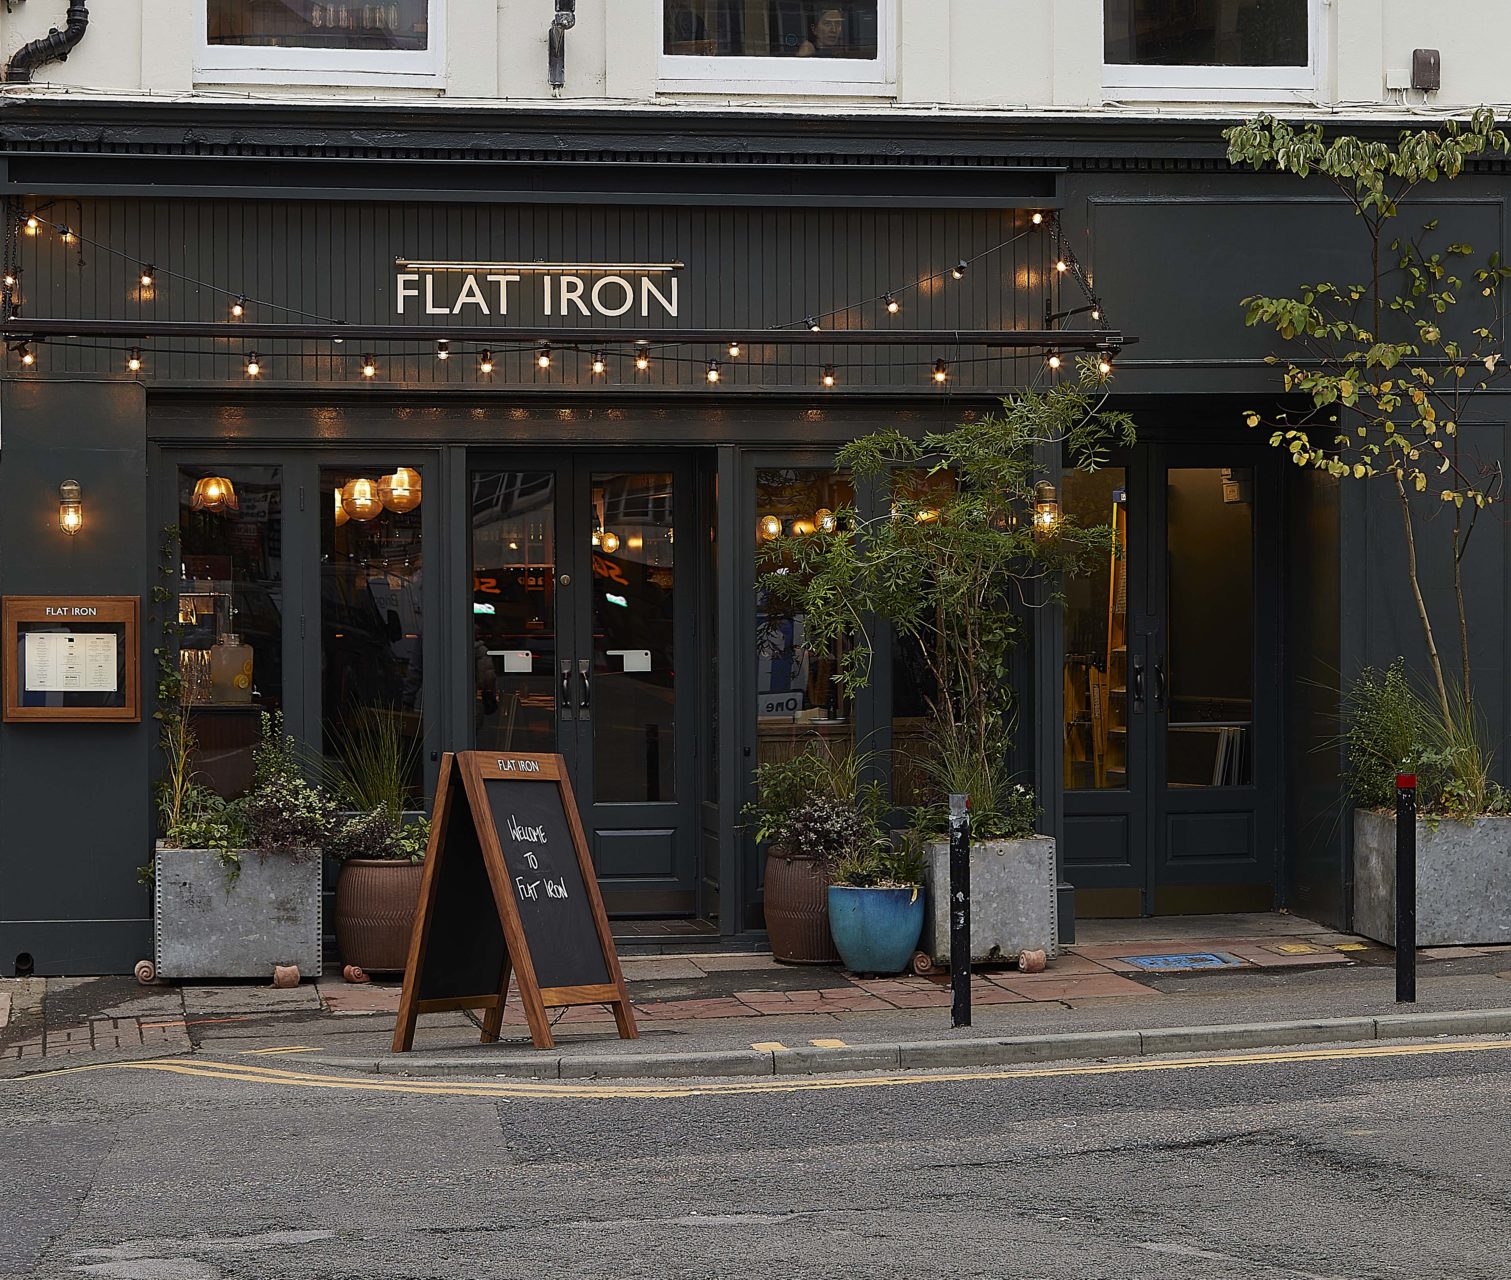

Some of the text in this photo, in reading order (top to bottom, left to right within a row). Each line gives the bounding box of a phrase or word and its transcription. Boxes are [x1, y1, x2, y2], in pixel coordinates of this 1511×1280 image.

[397, 274, 678, 317] FLAT IRON
[46, 607, 97, 616] FLAT IRON
[497, 759, 540, 772] FLAT IRON
[523, 851, 538, 869] TO
[515, 876, 568, 901] FLAT IRON
